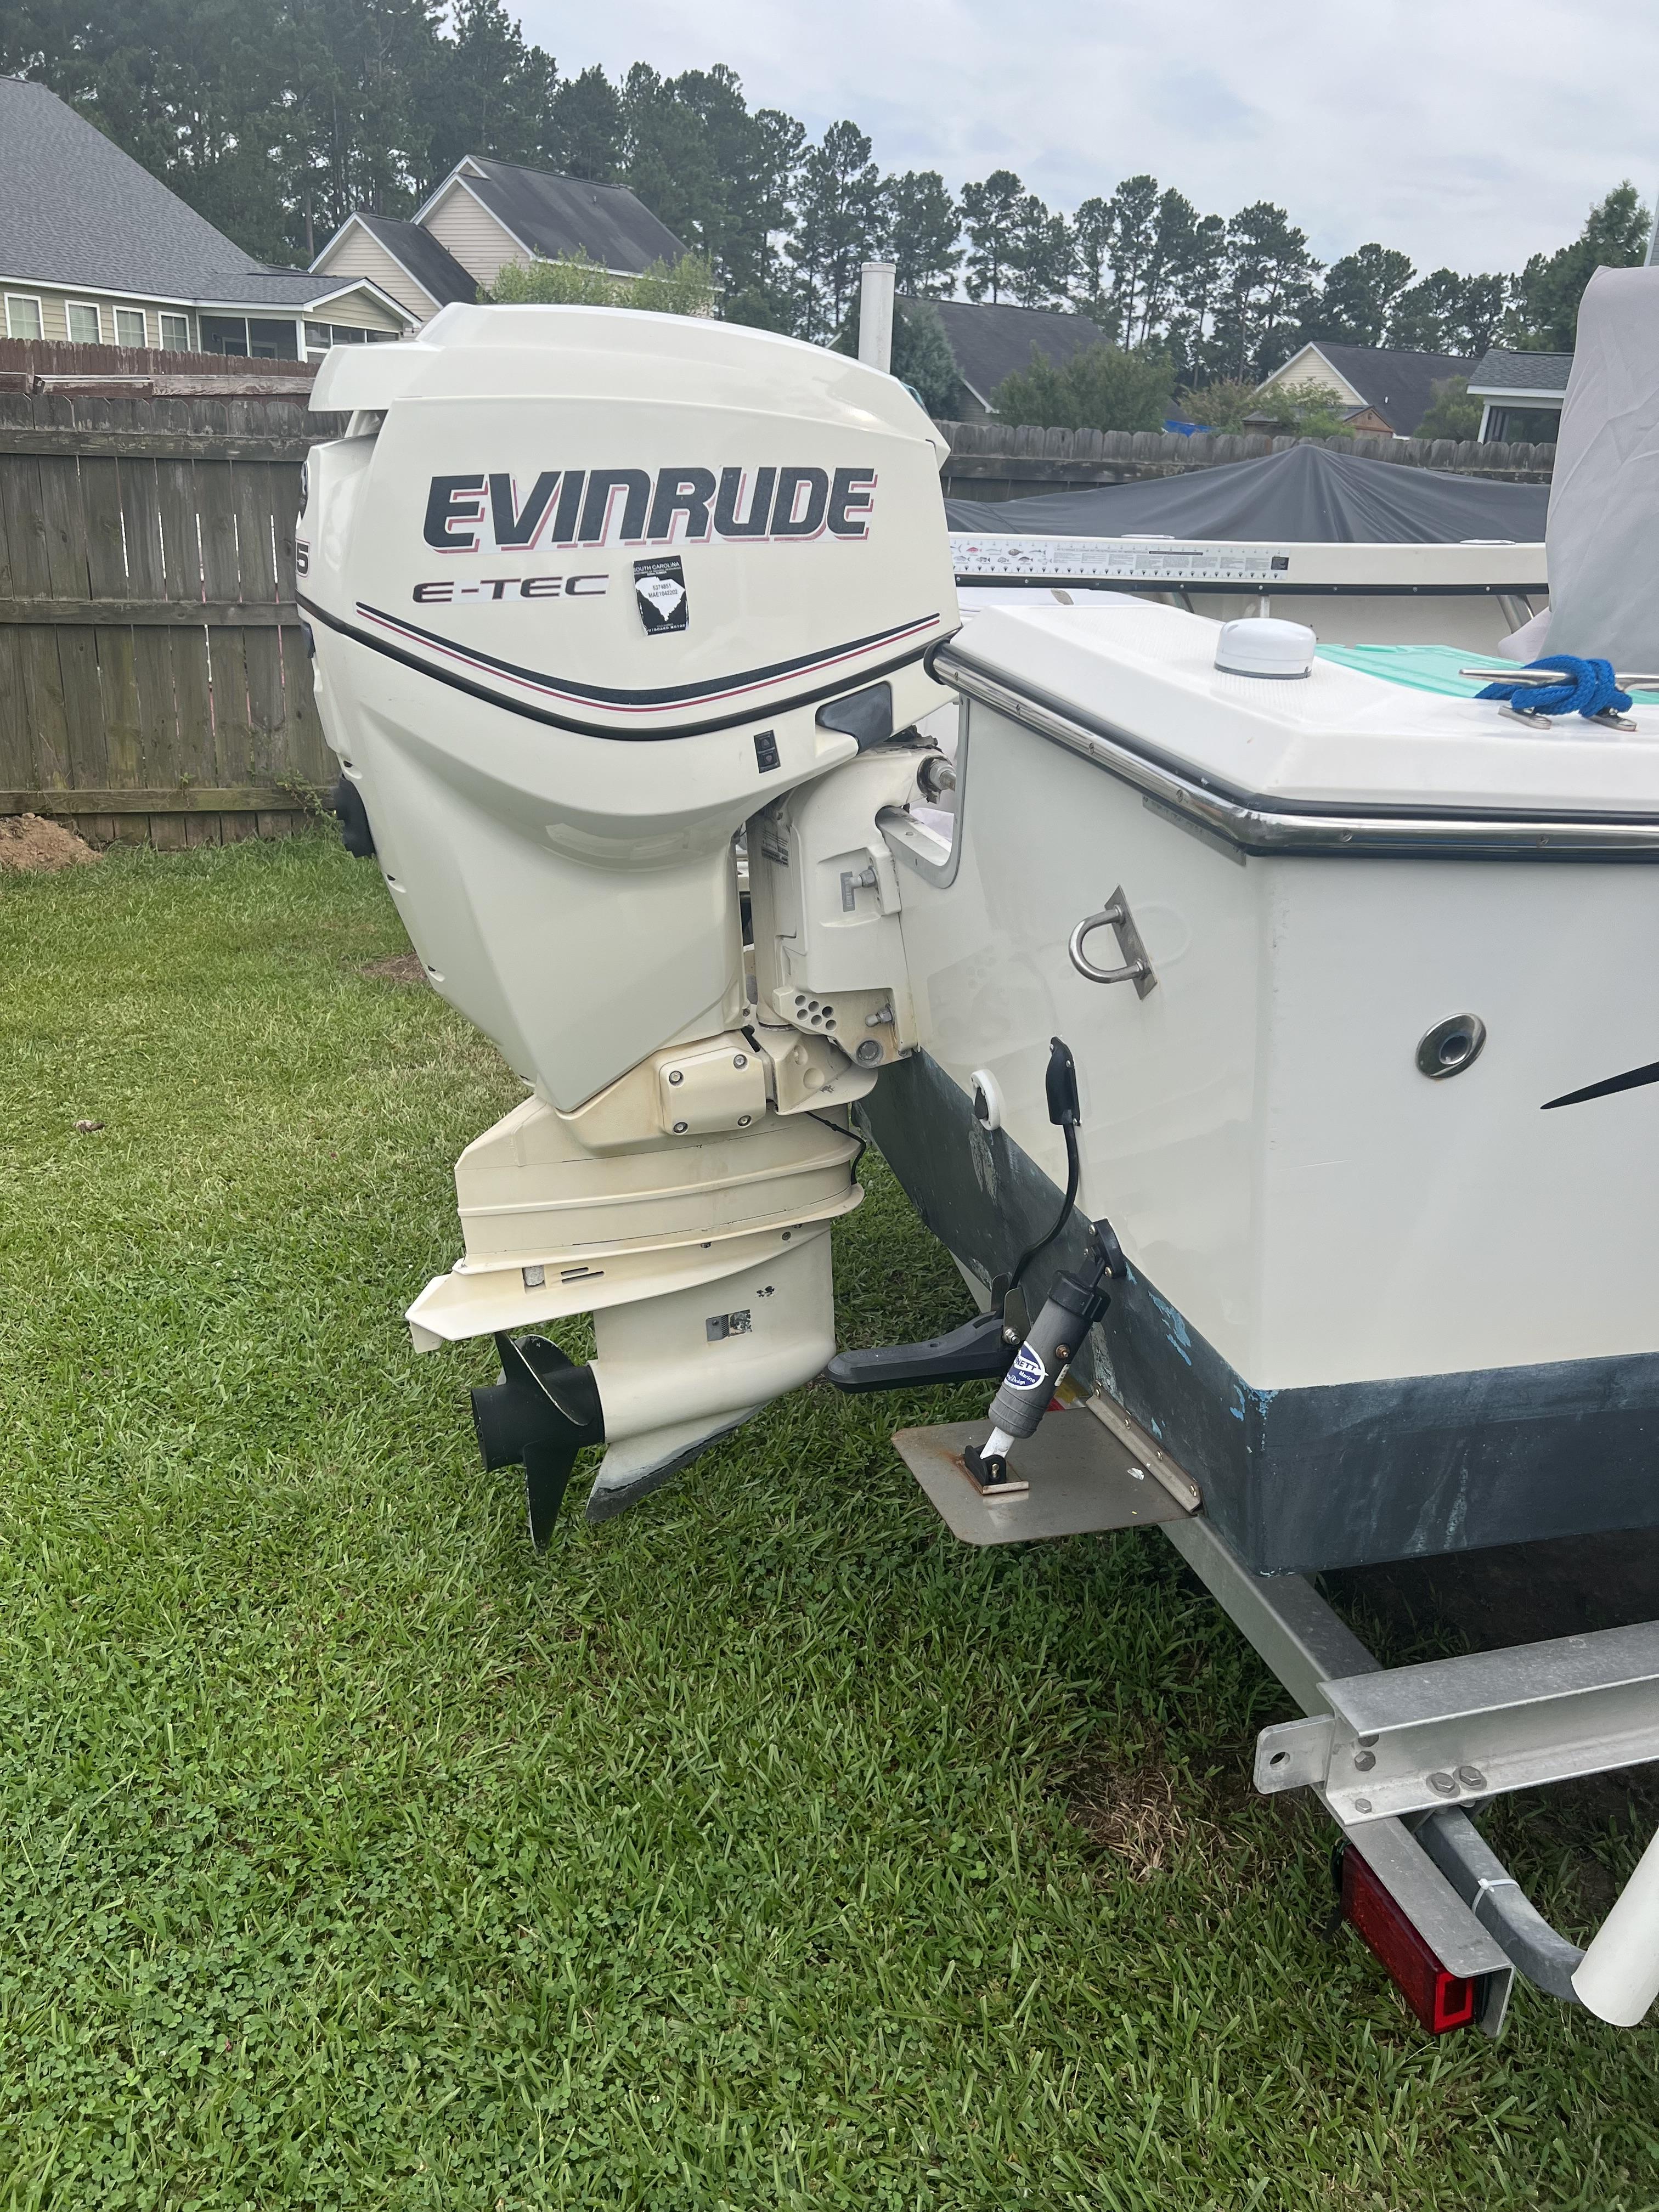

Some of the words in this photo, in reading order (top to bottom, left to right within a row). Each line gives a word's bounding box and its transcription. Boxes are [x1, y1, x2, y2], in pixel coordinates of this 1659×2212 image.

[423, 467, 878, 553] EVINRUDE
[652, 561, 680, 570] CAROLINA
[412, 574, 609, 603] E-TEC
[1019, 1370, 1036, 1383] Marine
